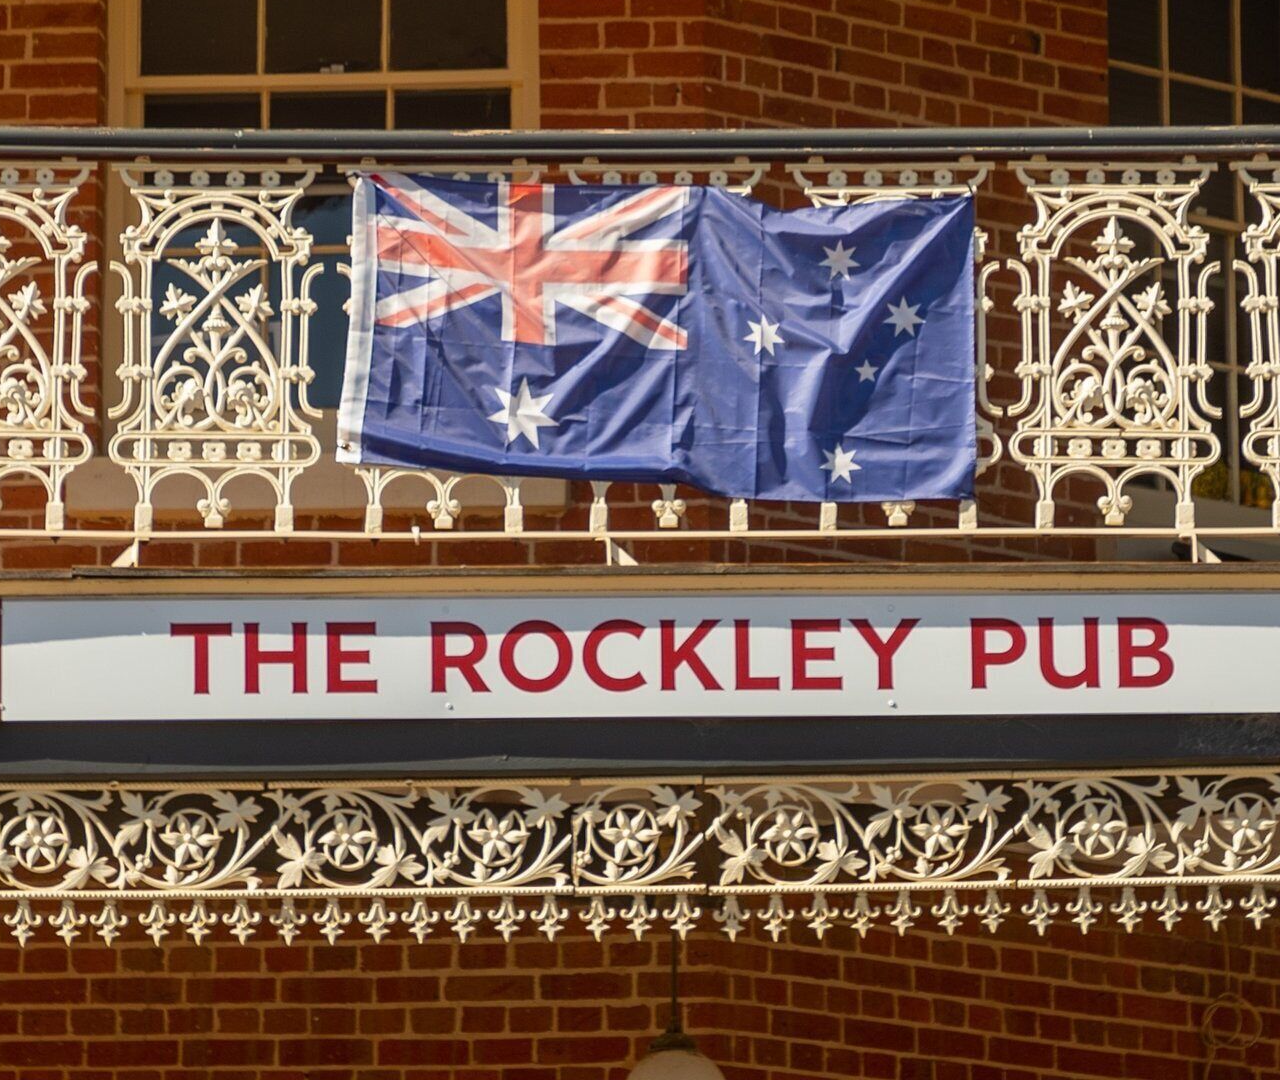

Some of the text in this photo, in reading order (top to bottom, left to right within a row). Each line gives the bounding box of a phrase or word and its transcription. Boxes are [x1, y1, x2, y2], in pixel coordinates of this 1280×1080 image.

[170, 617, 1175, 695] THE ROCKLEY PUB
